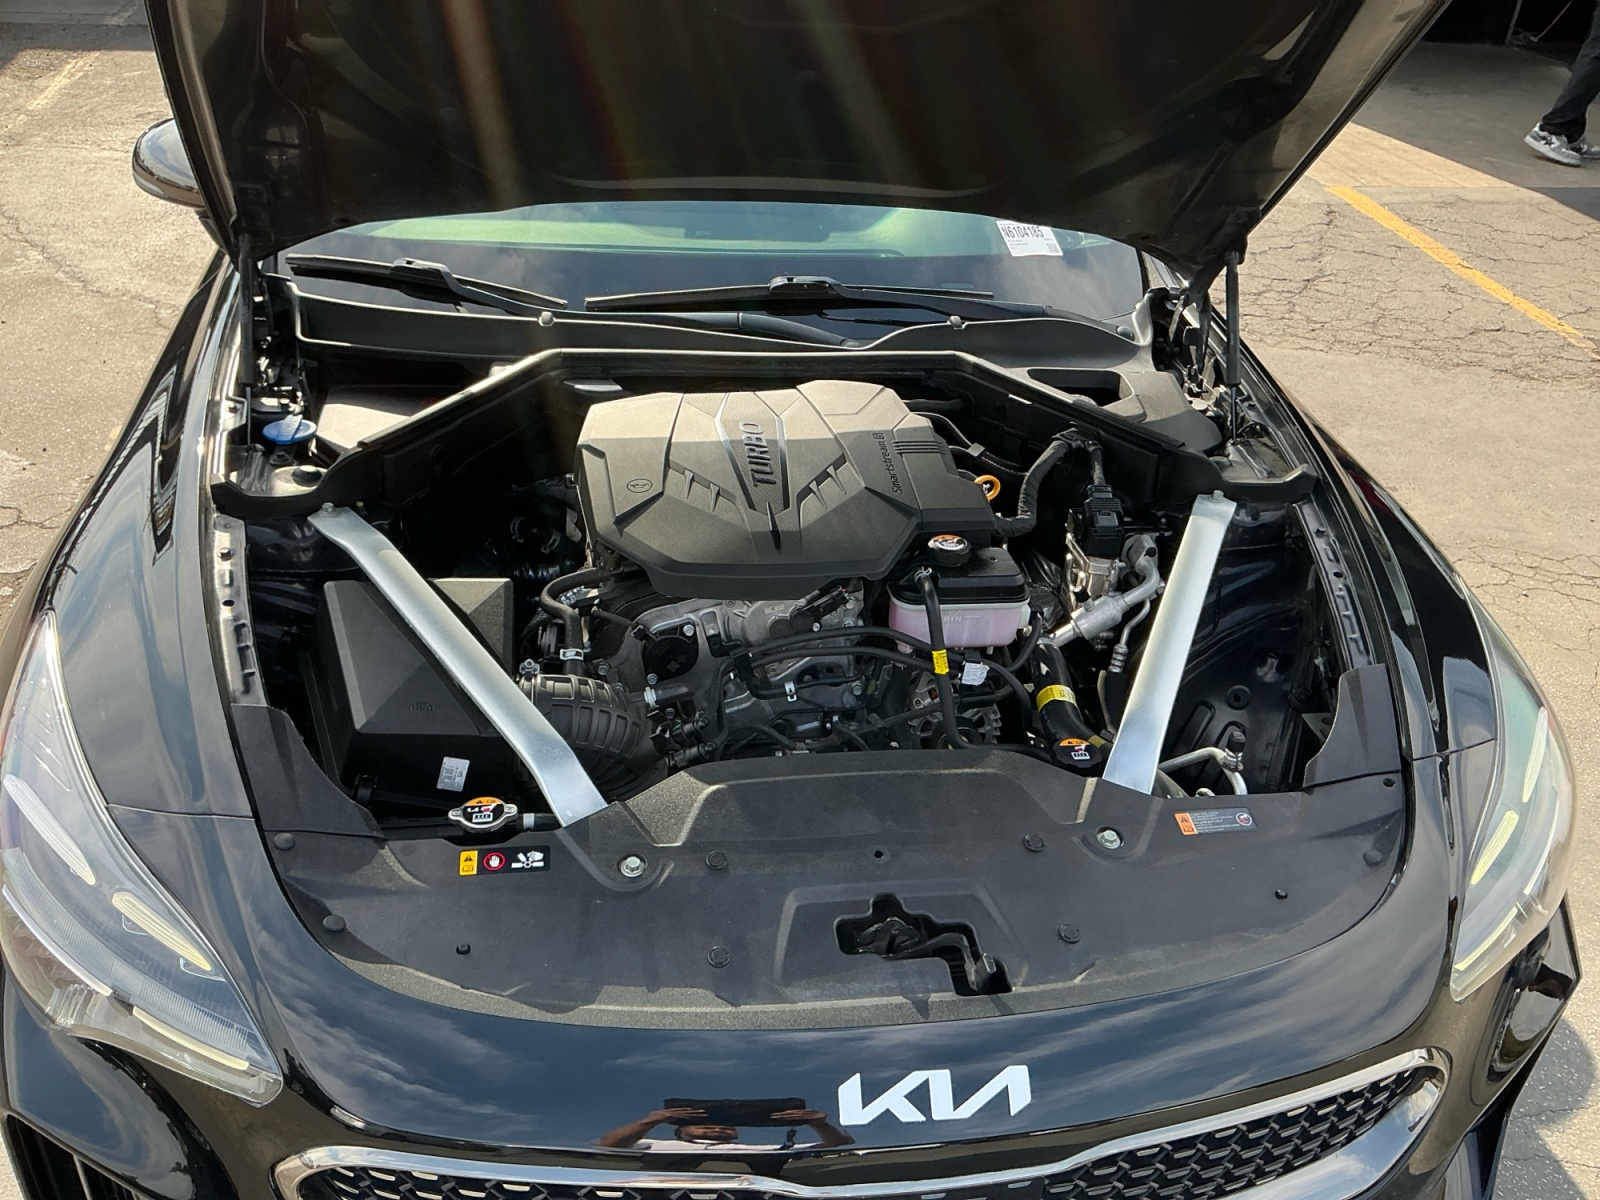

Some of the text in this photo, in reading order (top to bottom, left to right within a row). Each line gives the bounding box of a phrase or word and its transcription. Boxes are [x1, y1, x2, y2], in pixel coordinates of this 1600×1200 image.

[1001, 225, 1044, 238] N6104185
[739, 421, 777, 487] TURBO
[878, 441, 903, 494] Smartstream
[943, 615, 962, 623] MIN
[838, 1064, 1031, 1126] KIA
